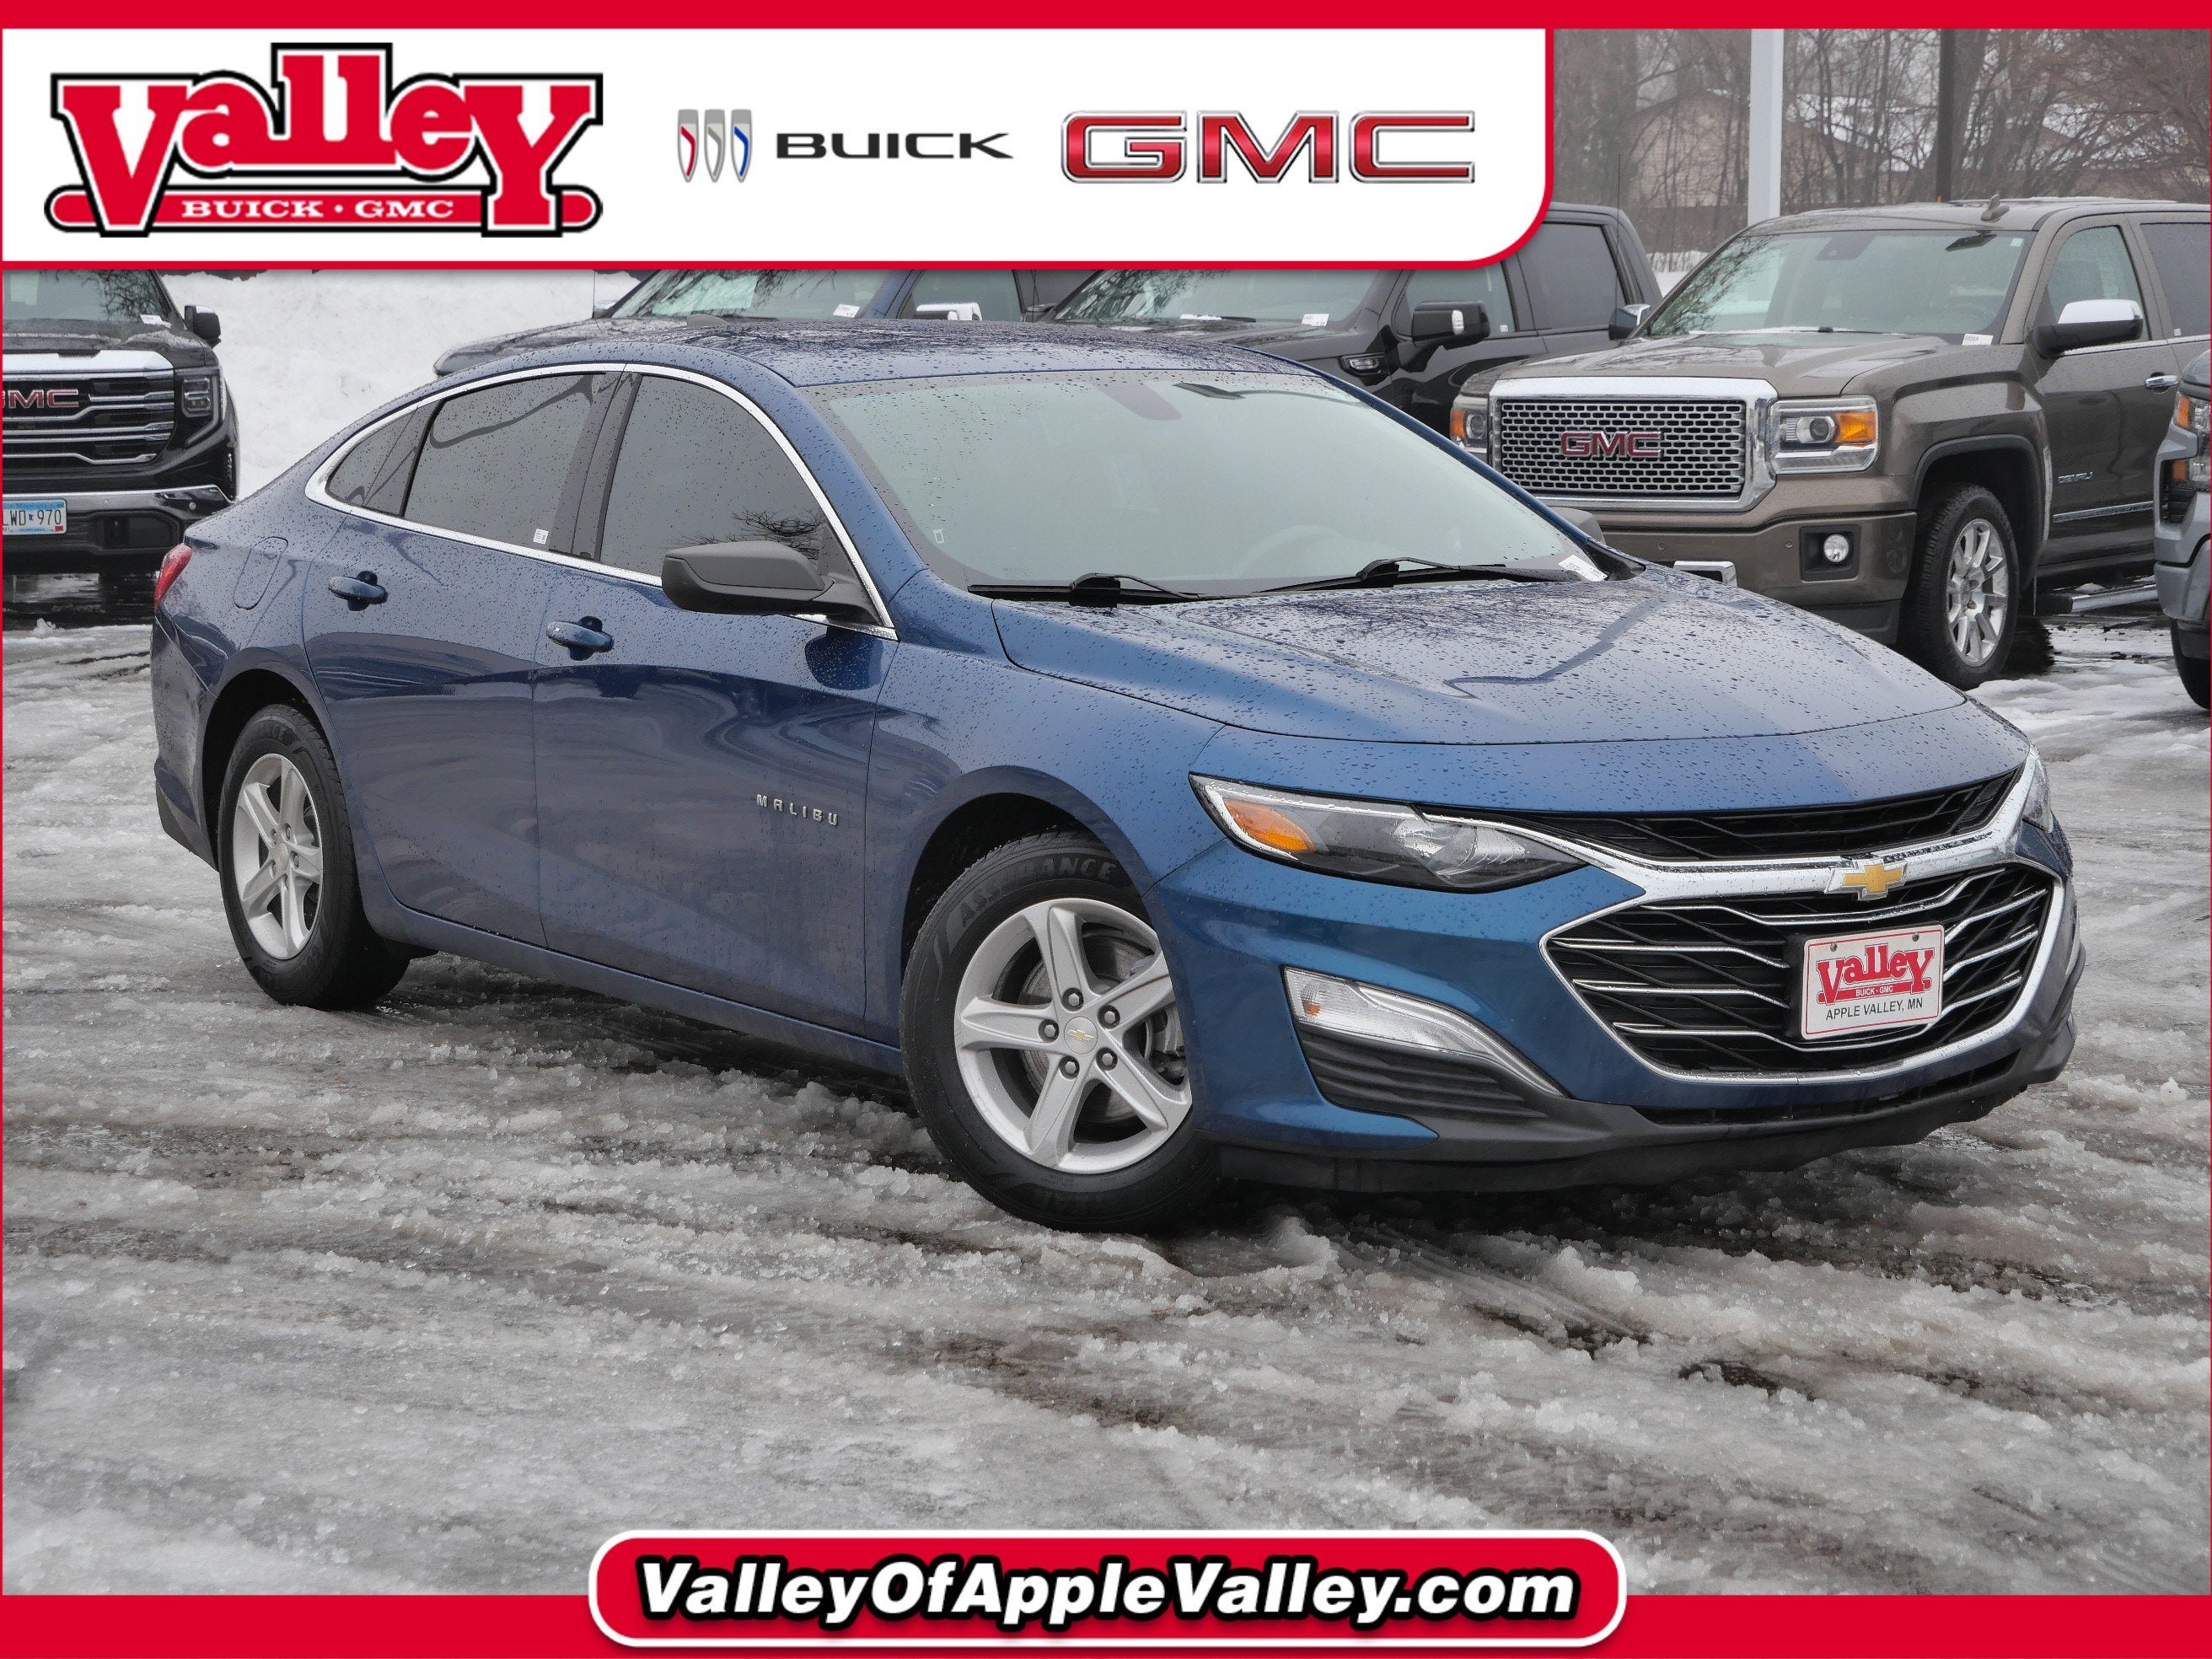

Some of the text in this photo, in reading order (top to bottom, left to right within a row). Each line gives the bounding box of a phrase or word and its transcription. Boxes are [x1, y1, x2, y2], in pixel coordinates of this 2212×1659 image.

[1560, 430, 1662, 458] GMC
[37, 509, 62, 525] 970
[756, 793, 838, 826] MALIBU
[1817, 943, 1935, 1005] Valley
[1856, 985, 1894, 997] BUICK GMC
[1825, 996, 1923, 1020] APPLE VALLEY, MN
